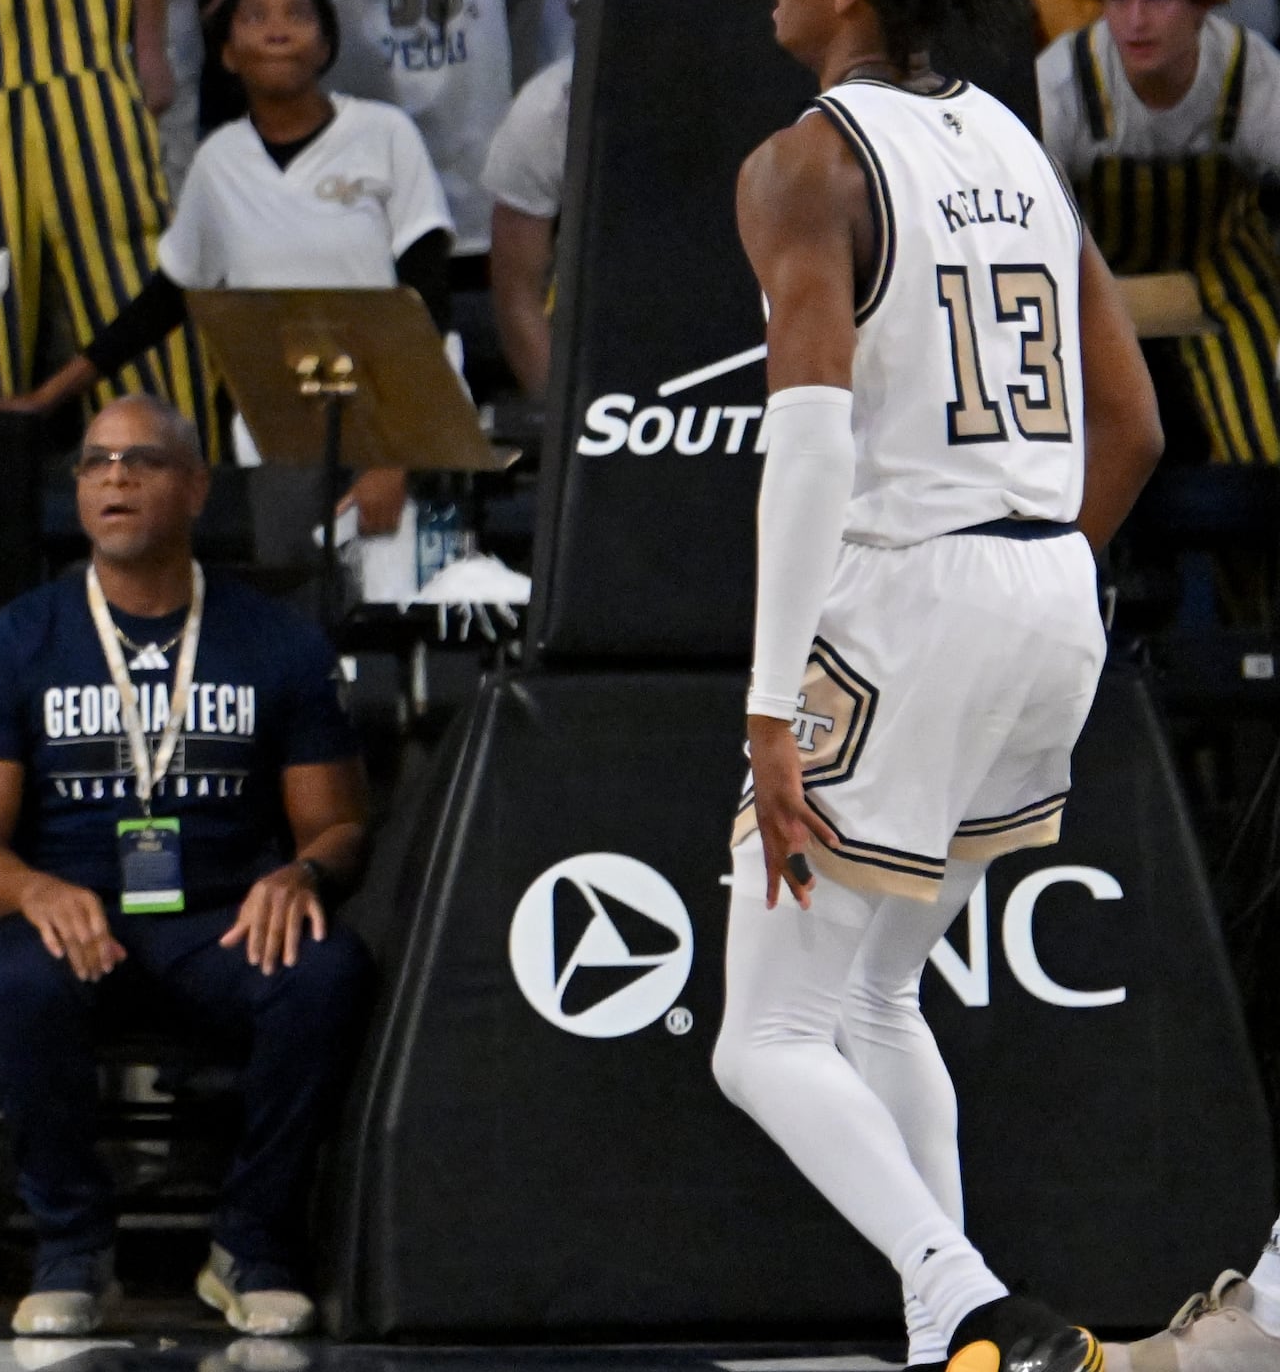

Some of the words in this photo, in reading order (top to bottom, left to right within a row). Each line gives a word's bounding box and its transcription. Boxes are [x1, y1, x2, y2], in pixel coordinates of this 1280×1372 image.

[938, 188, 1035, 233] KELLY
[936, 263, 1073, 446] 13
[185, 682, 255, 737] TECH
